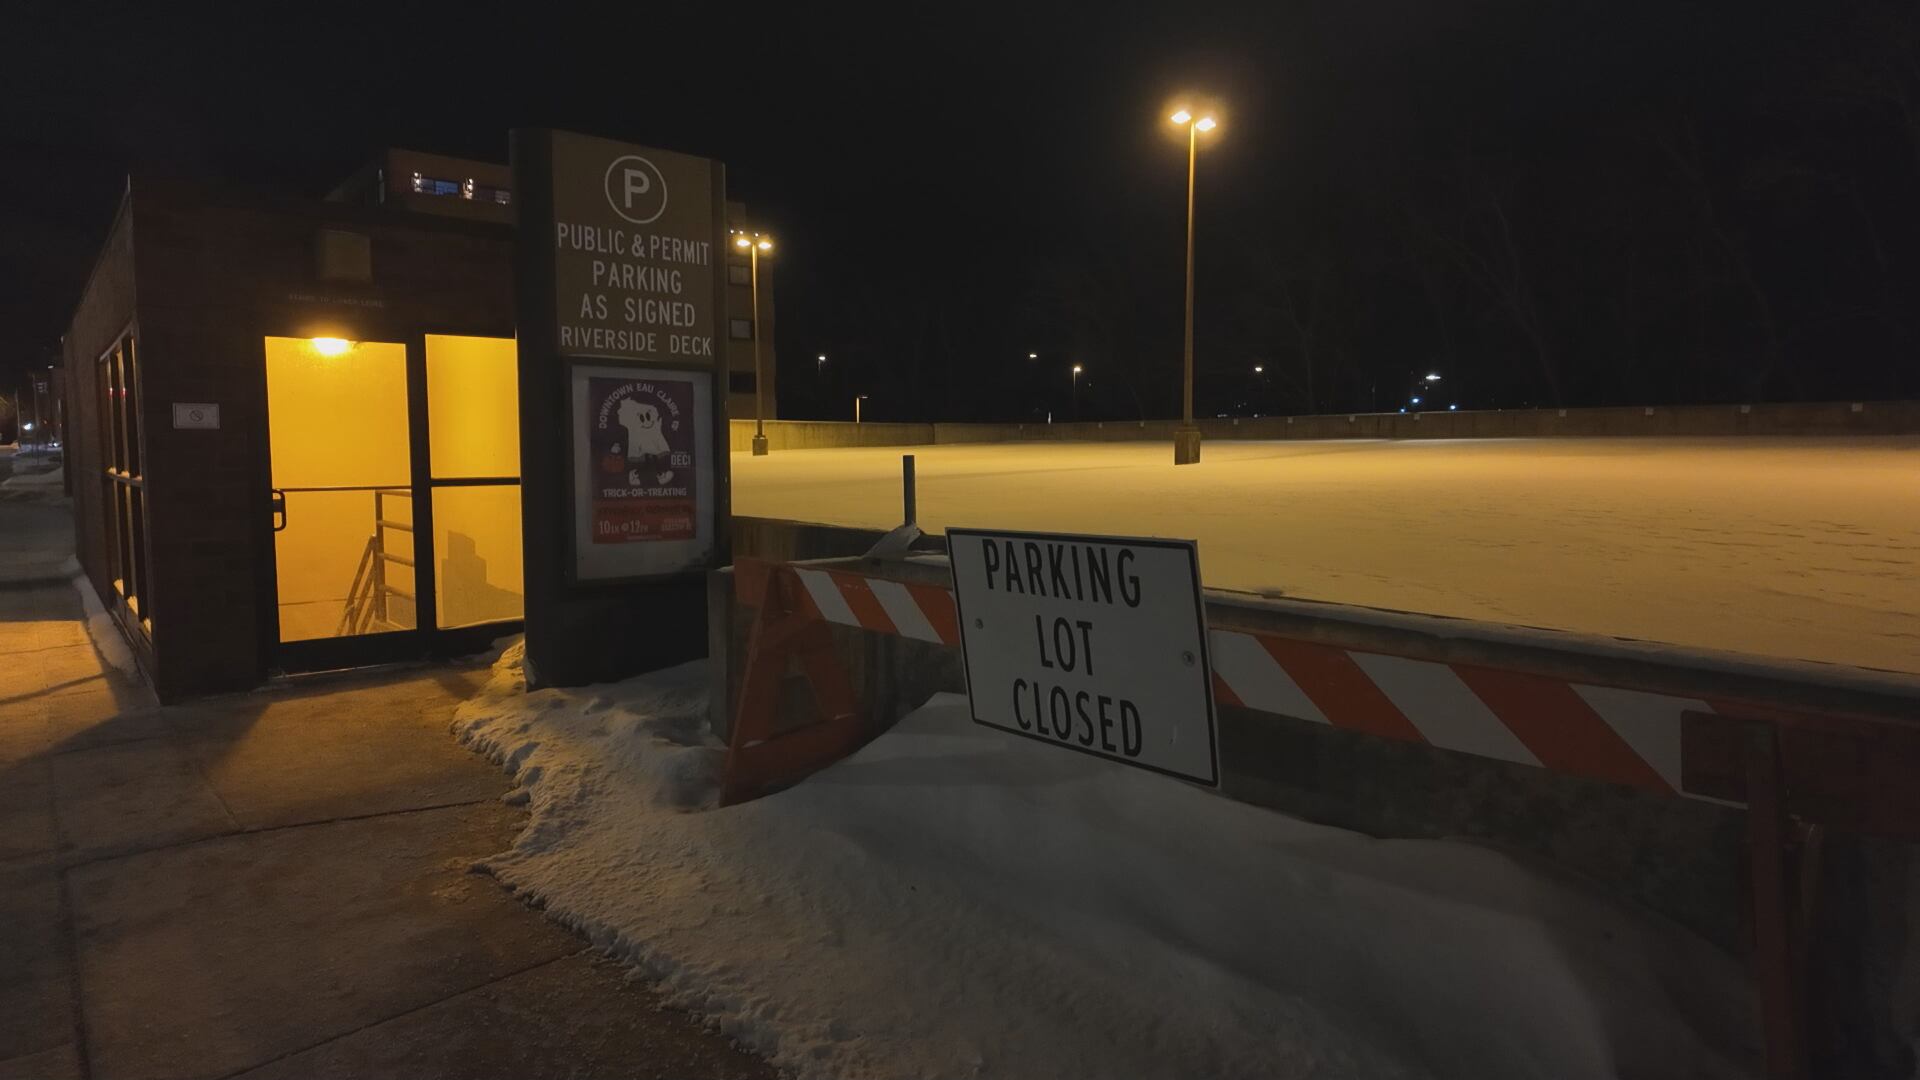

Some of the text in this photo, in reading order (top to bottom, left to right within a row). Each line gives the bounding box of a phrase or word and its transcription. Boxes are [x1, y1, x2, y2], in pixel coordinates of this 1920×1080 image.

[624, 168, 650, 208] P
[557, 222, 709, 266] PUBLIC & PERMIT
[593, 260, 682, 294] PARKING
[581, 293, 695, 327] AS SIGNED
[561, 326, 712, 356] RIVERSIDE DECK
[598, 383, 681, 430] DOWNTOWN EAU CLAIRE
[671, 454, 691, 466] DECI
[602, 487, 689, 498] TRICK-OR-TREATING
[981, 538, 1141, 608] PARKING
[1036, 614, 1093, 676] LOT
[1013, 678, 1142, 758] CLOSED
